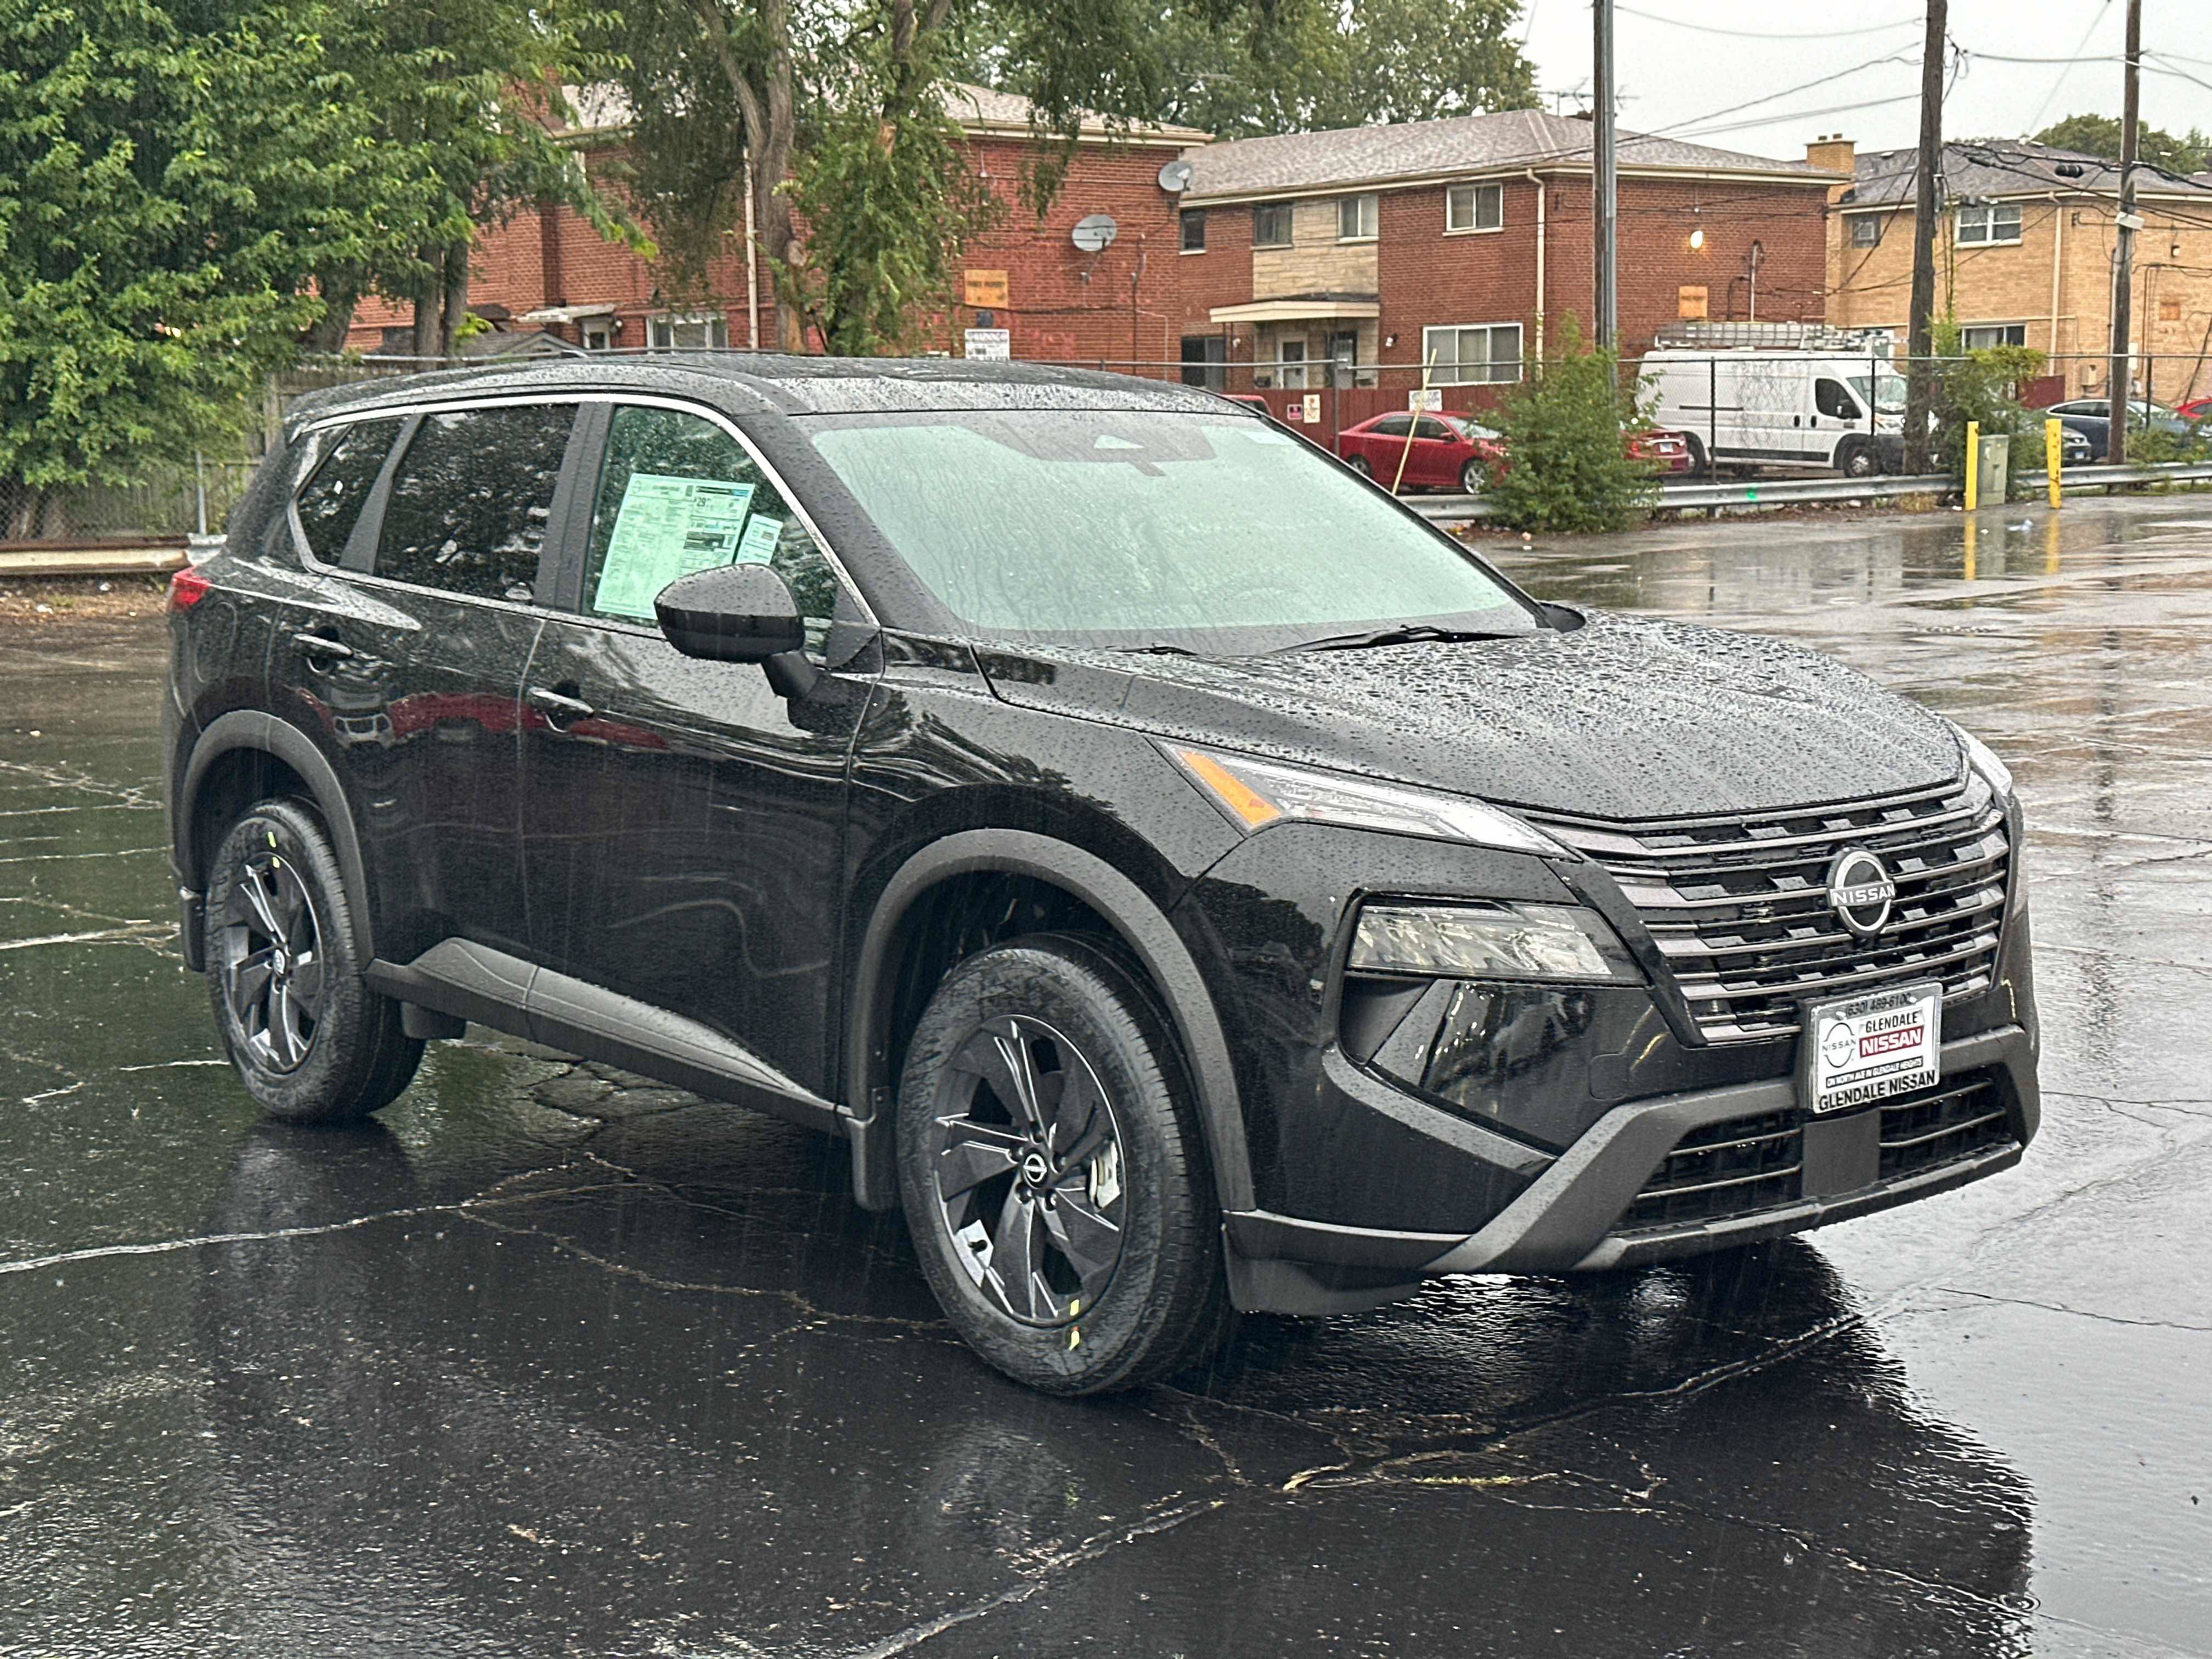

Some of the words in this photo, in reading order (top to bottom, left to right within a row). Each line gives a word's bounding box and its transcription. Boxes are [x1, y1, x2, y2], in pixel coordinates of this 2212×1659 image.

[1832, 884, 1896, 905] NISSAN
[1866, 1011, 1919, 1033] GLENDALE
[1821, 1037, 1857, 1052] NISSAN
[1861, 1026, 1922, 1057] NISSAN
[1819, 1081, 1886, 1111] GLENDALE
[1889, 1070, 1936, 1096] NISSAN
